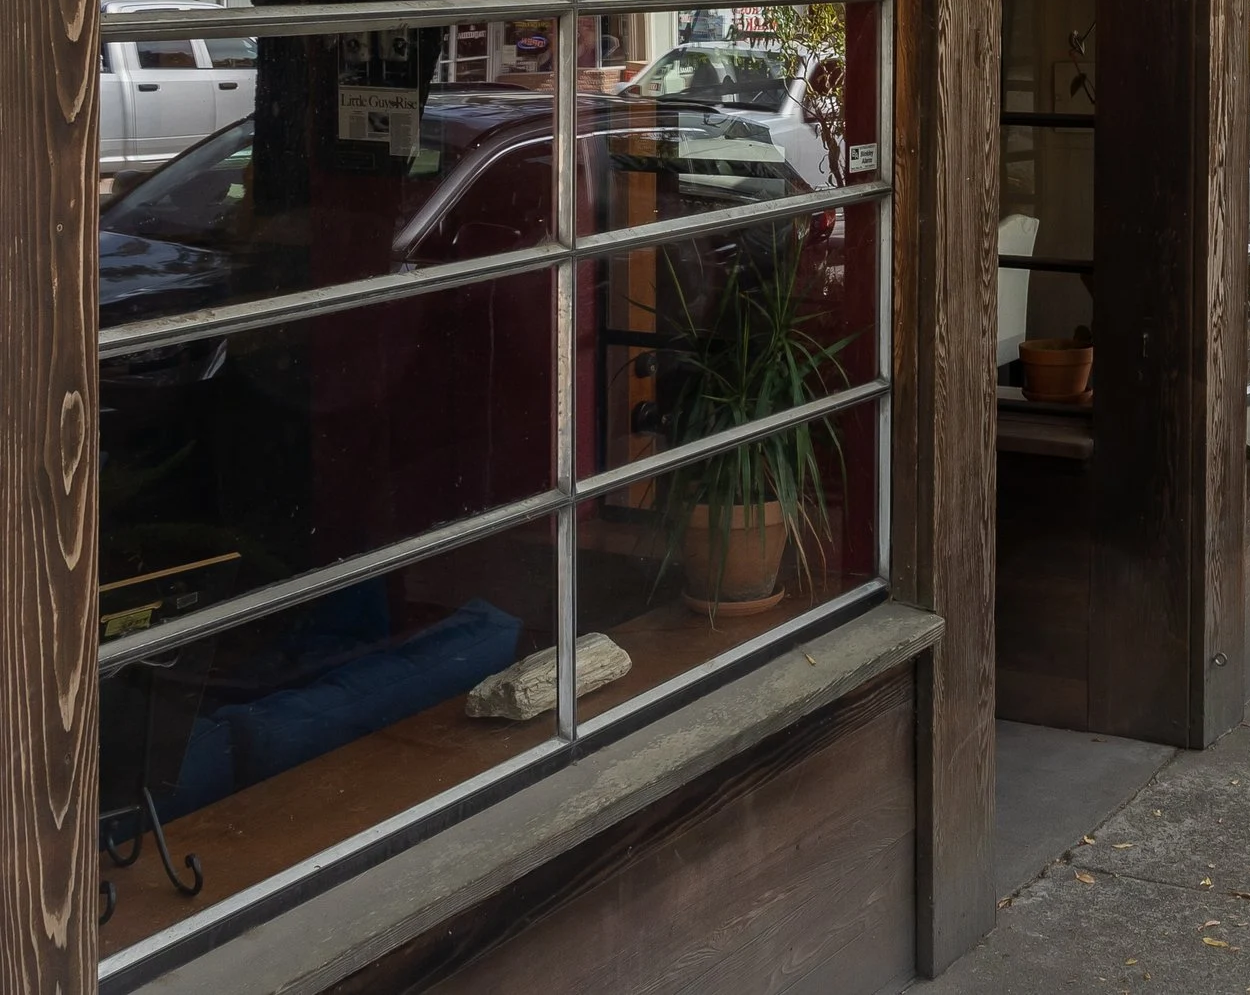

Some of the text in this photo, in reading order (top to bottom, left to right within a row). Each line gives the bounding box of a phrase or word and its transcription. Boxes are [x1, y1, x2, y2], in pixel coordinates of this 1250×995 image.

[341, 93, 418, 111] Little Guys Rise
